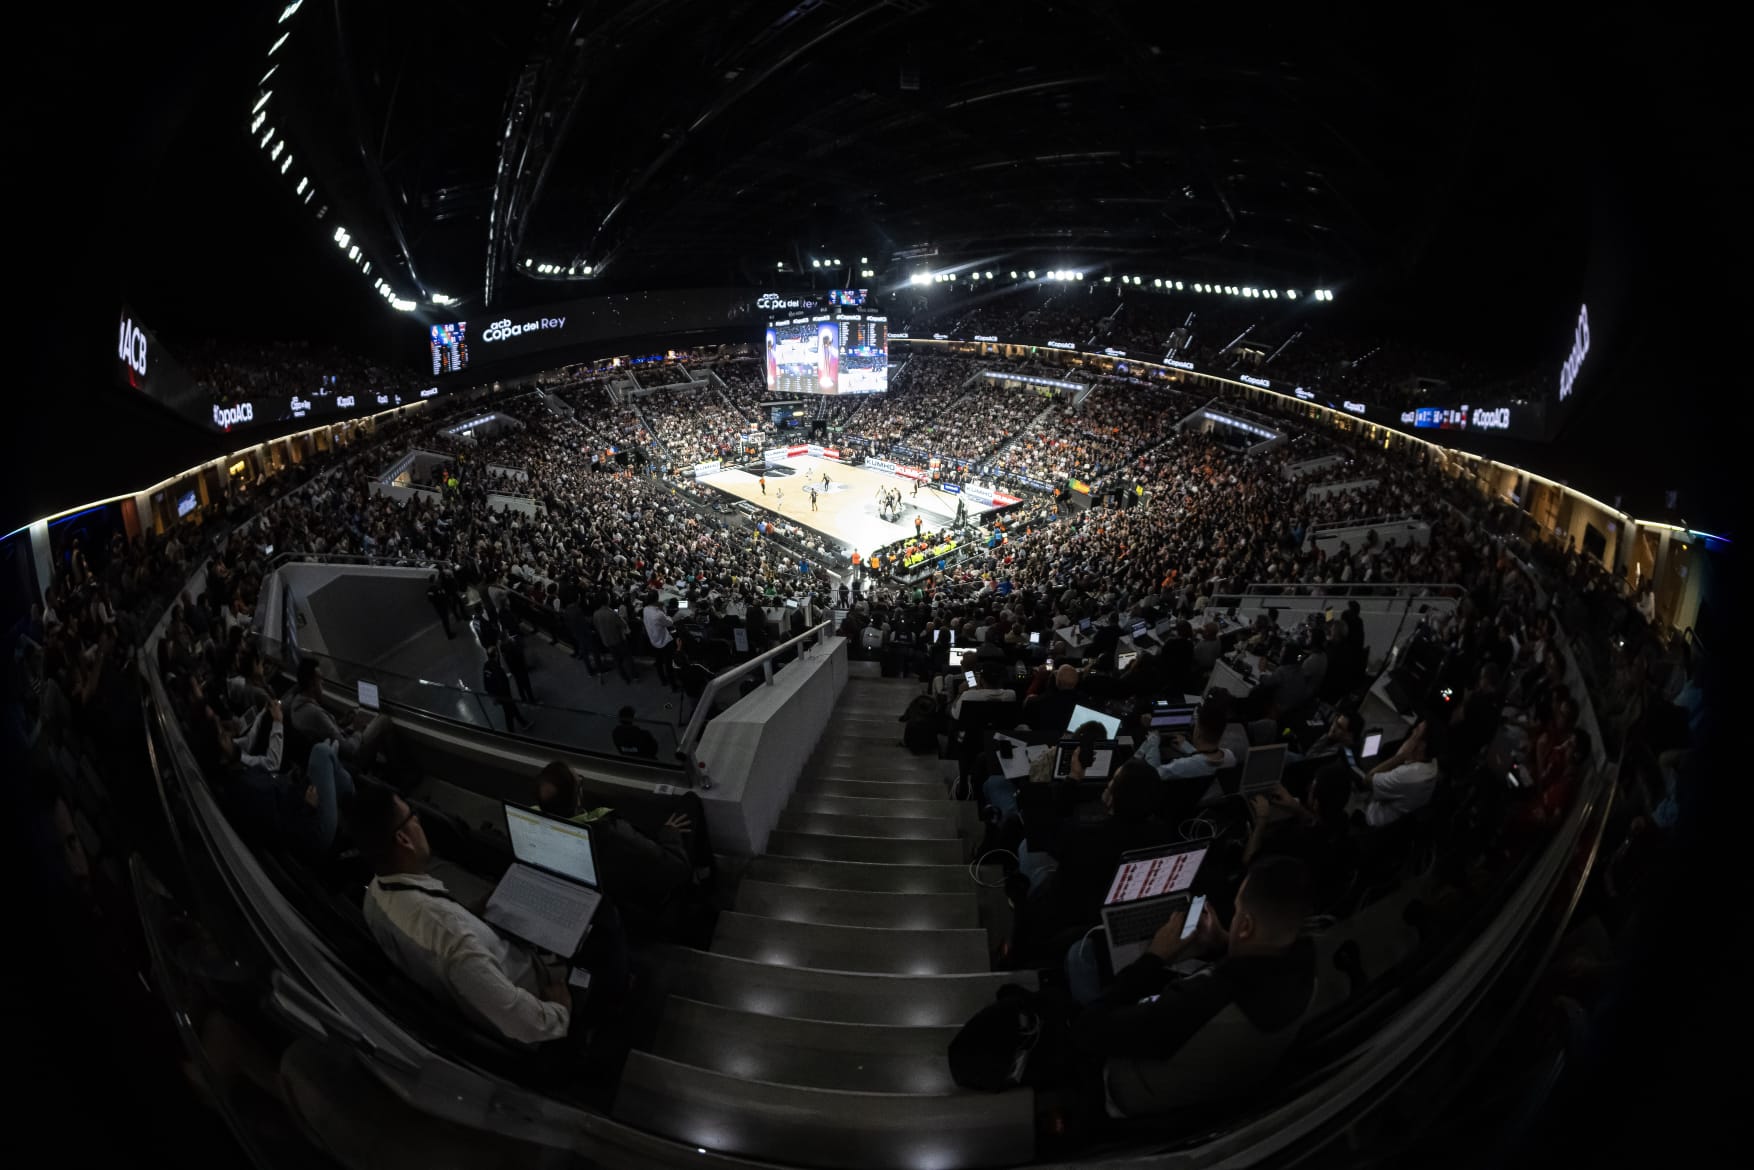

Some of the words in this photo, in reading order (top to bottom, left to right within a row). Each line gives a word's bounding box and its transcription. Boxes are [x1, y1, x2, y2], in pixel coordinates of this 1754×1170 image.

[787, 299, 799, 308] del
[483, 324, 522, 342] Copa
[523, 321, 539, 332] del
[541, 317, 566, 330] Rey
[490, 319, 512, 330] acb
[1163, 358, 1194, 370] #CopaACB
[1473, 408, 1510, 429] #CopaACB
[866, 458, 895, 471] KUMHO
[966, 486, 993, 498] KUMHO
